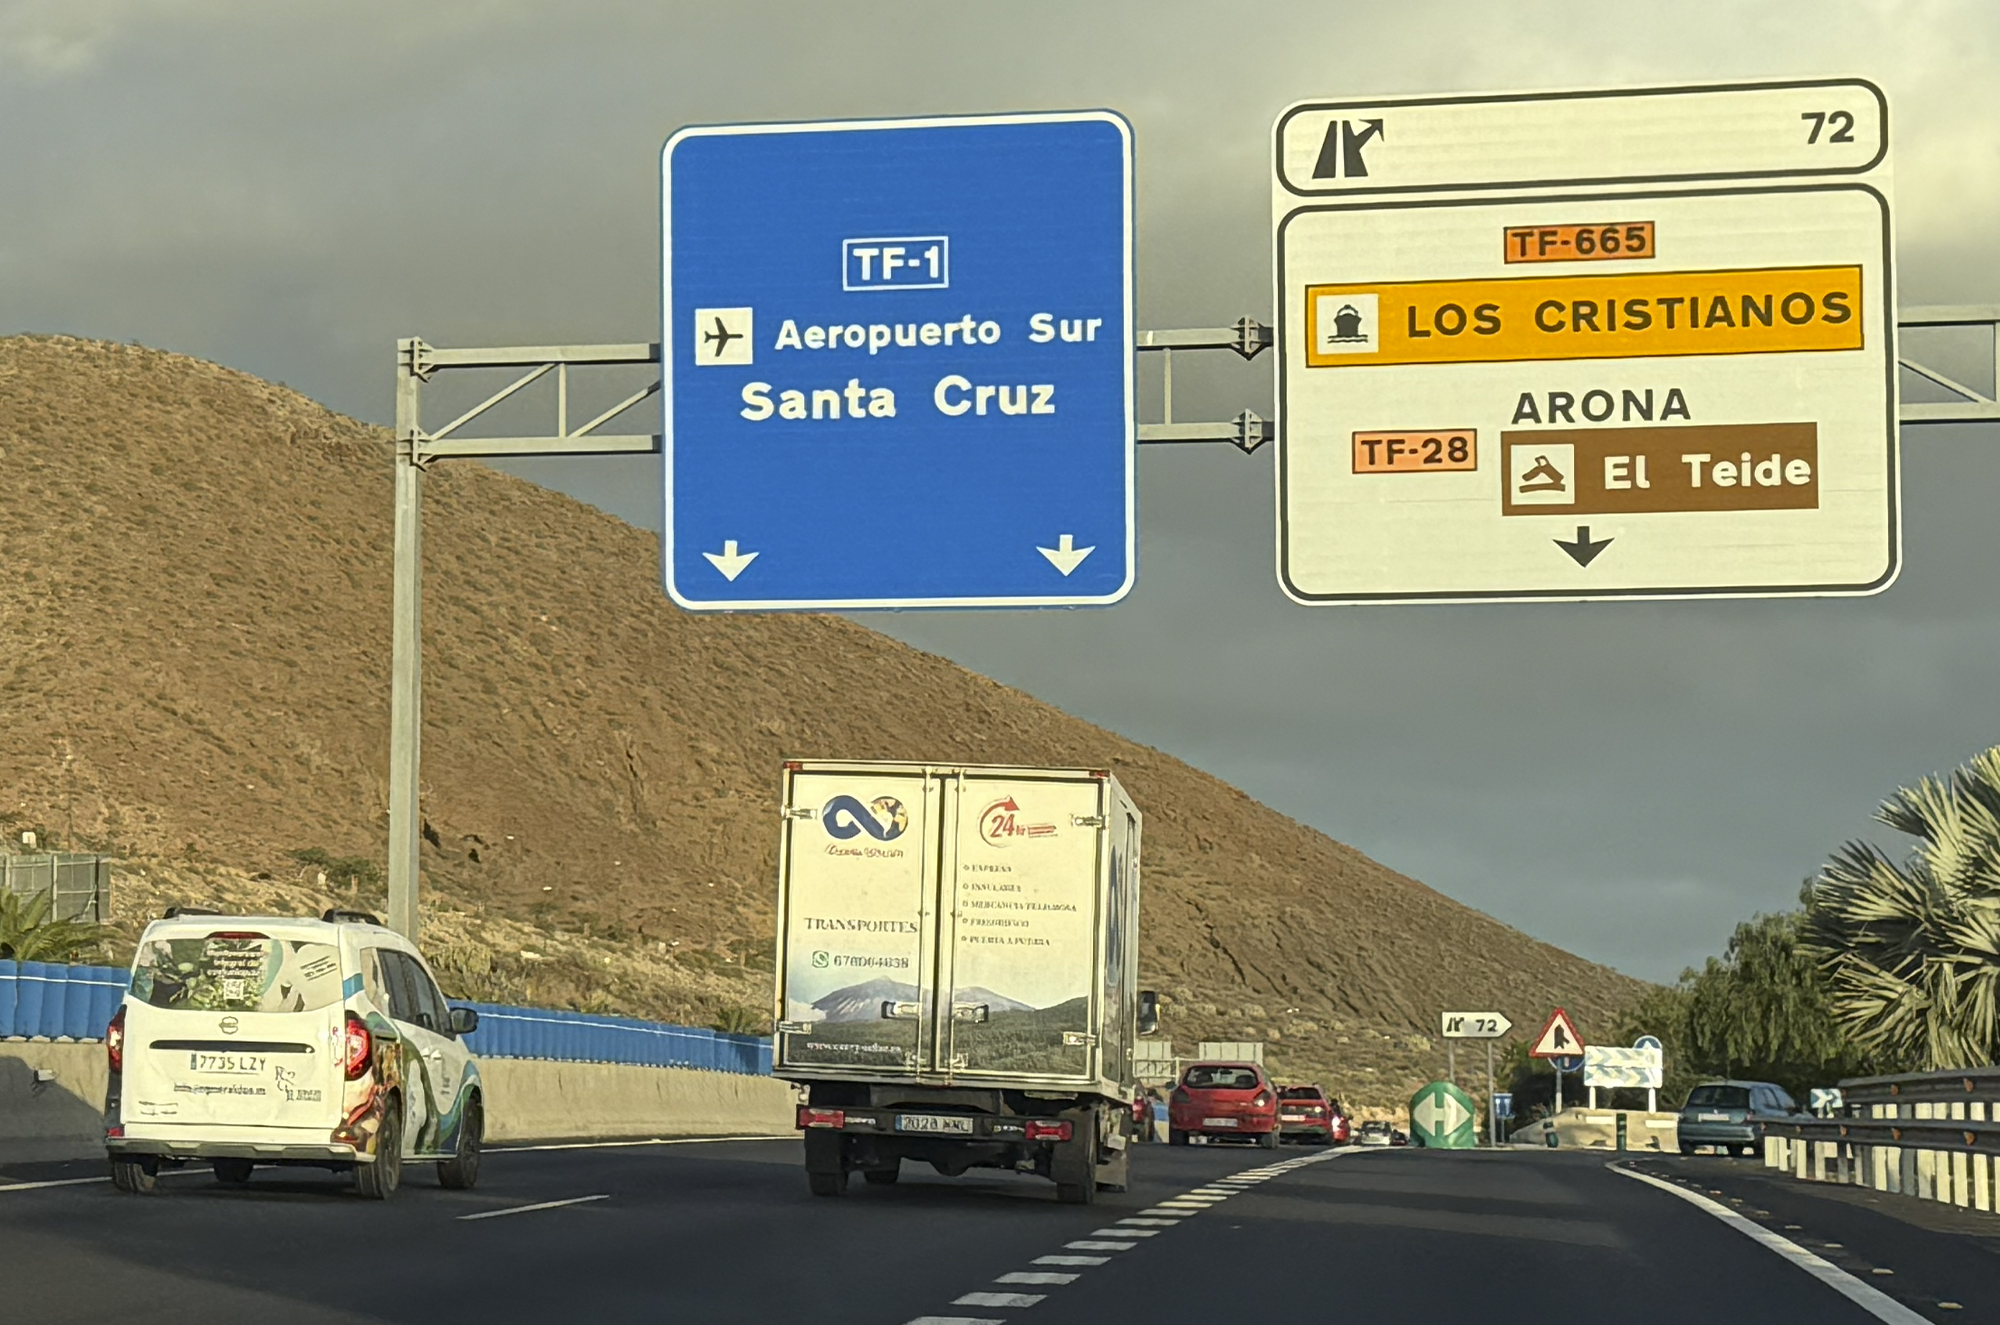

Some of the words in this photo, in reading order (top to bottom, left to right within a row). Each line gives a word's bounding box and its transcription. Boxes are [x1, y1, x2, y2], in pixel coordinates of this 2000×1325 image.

[1801, 110, 1856, 145] 72
[1512, 226, 1647, 258] TF-665
[852, 244, 941, 282] TF-1
[1408, 303, 1502, 339] LOS
[1534, 290, 1852, 334] CRISTIANOS
[774, 313, 1002, 355] Aeropuerto
[1028, 312, 1103, 344] Sur
[740, 378, 897, 421] Santa
[933, 373, 1056, 417] Cruz
[1511, 387, 1692, 425] ARONA
[1360, 437, 1470, 467] TF-28
[1604, 455, 1650, 491] El
[1682, 452, 1812, 489] Teide
[804, 917, 918, 933] TRANSPORTES
[1475, 1018, 1498, 1033] 72
[200, 1054, 235, 1070] 7735
[240, 1056, 266, 1071] LZY
